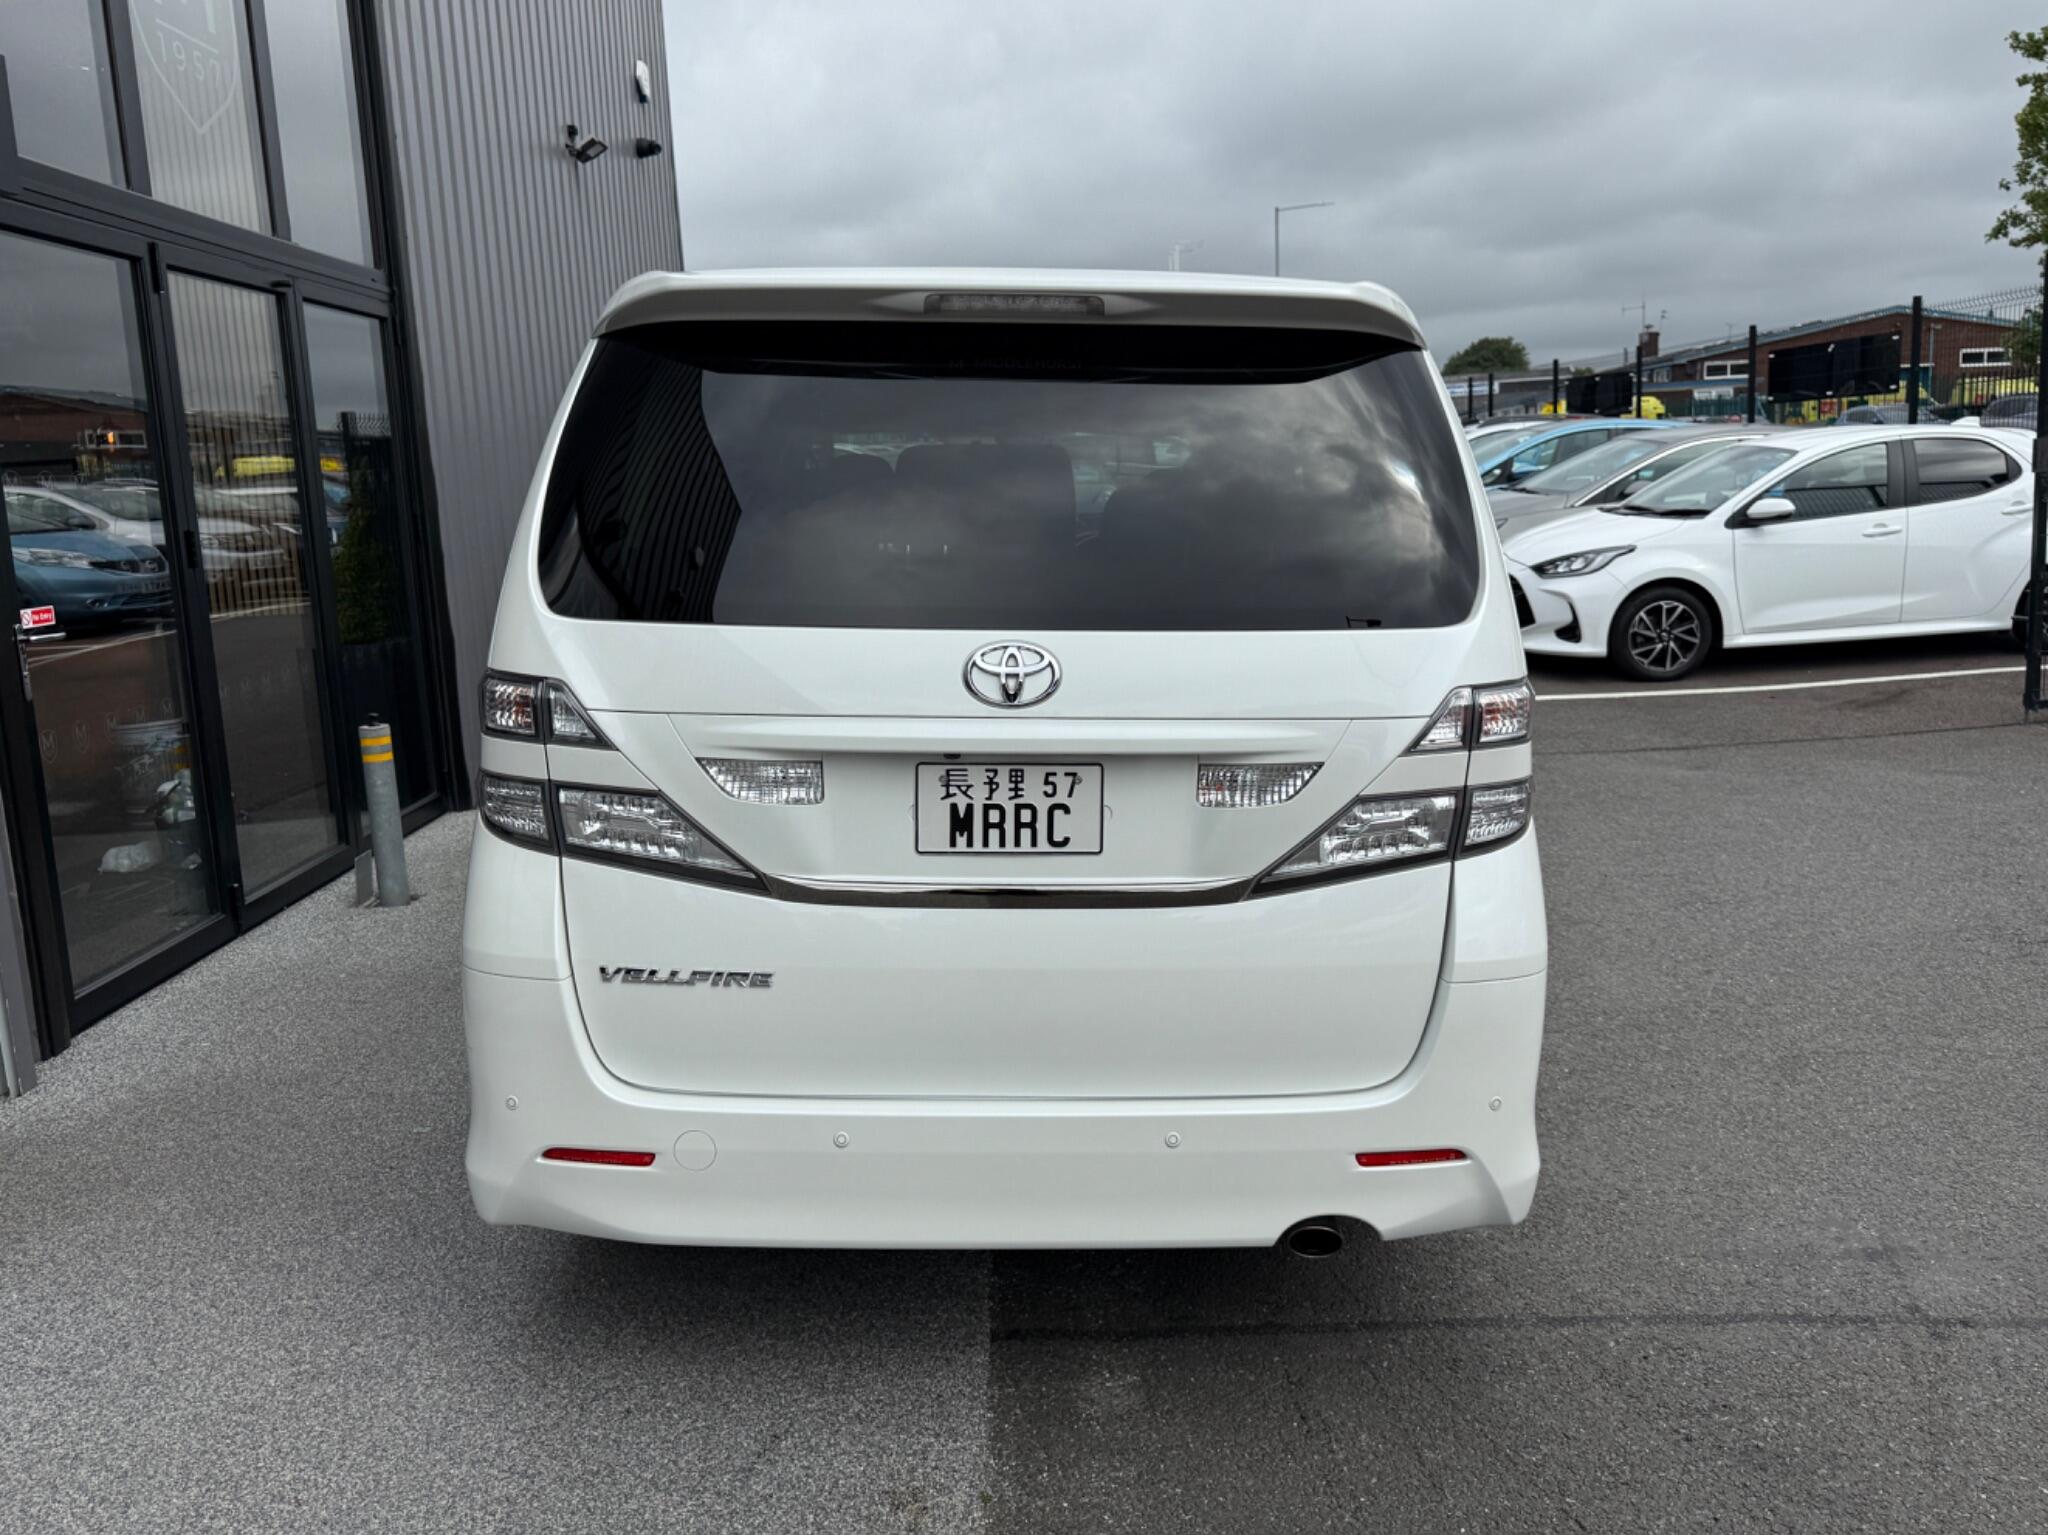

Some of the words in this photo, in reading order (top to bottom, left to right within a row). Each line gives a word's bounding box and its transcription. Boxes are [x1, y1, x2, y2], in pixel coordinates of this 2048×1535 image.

[157, 31, 220, 88] 1957
[1042, 772, 1078, 798] 57
[949, 802, 1071, 848] MRRC
[599, 966, 775, 988] VELLFIRE
